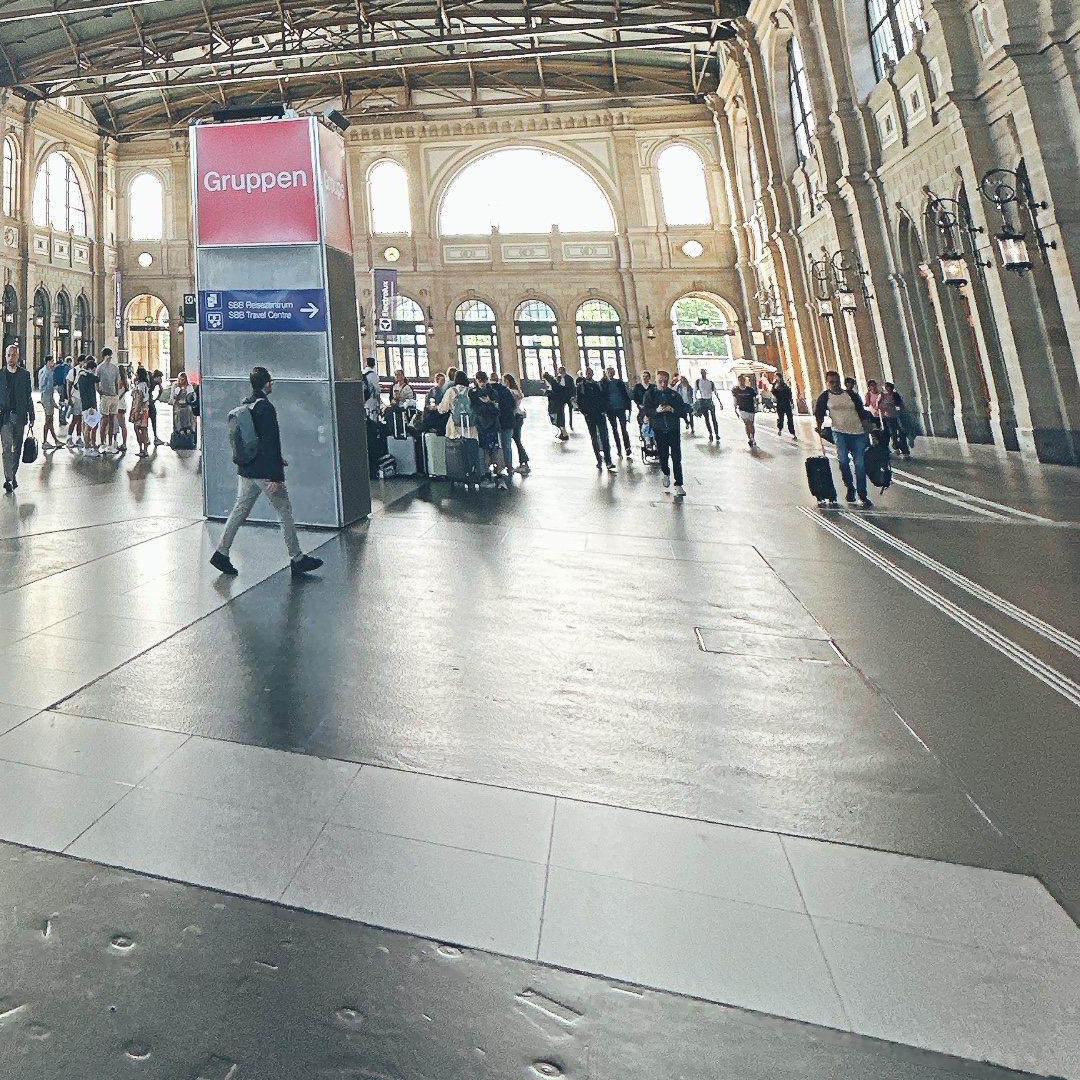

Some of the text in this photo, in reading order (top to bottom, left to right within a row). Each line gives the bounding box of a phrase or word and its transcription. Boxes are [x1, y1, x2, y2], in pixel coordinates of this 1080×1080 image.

[203, 169, 307, 193] Gruppen
[227, 301, 294, 309] SBB Reisezentrum
[381, 280, 389, 317] Electrolux
[228, 311, 292, 319] SBB Travel Centre
